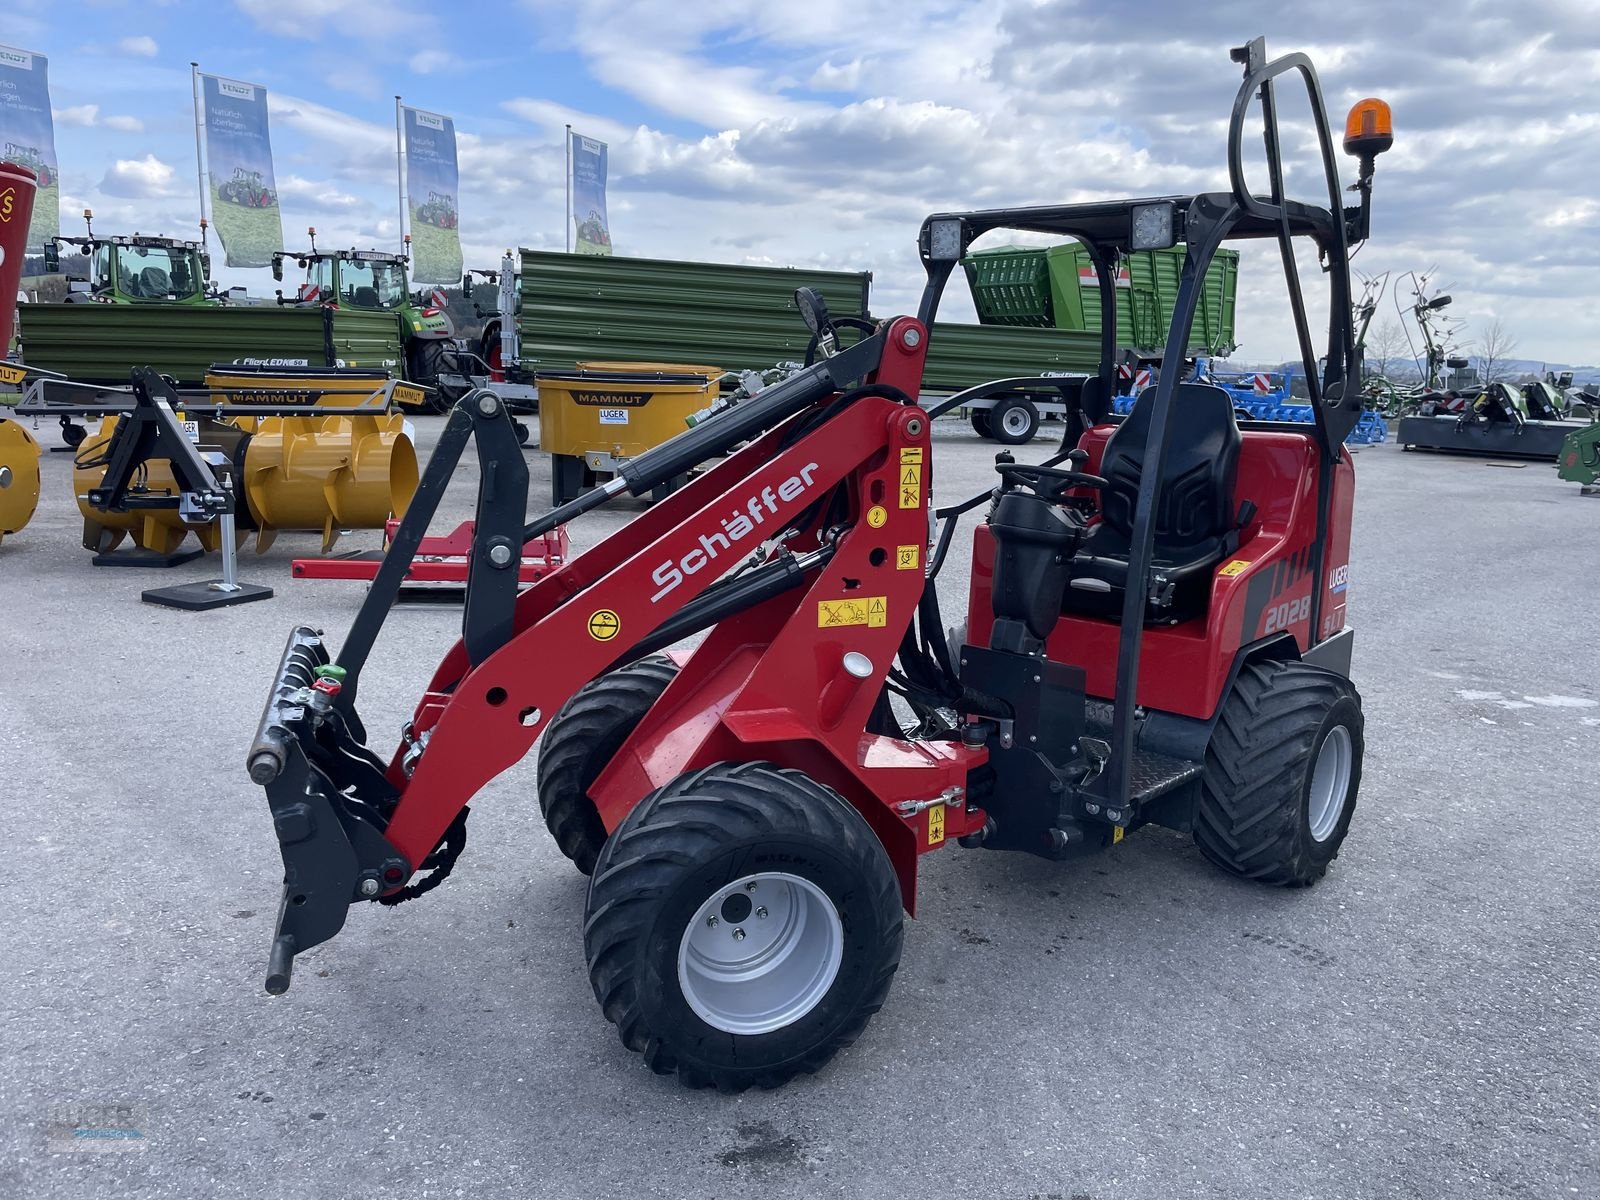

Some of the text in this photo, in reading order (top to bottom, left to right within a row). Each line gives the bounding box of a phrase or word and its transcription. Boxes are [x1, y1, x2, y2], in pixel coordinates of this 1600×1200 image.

[0, 51, 28, 63] ENDT
[232, 394, 309, 403] MAMMUT
[394, 388, 421, 401] MAMMUT
[579, 394, 642, 404] MAMMUT
[600, 410, 624, 418] LUGER
[650, 462, 819, 604] Schäffer
[1328, 564, 1350, 590] LUGER
[1264, 595, 1311, 634] 2028
